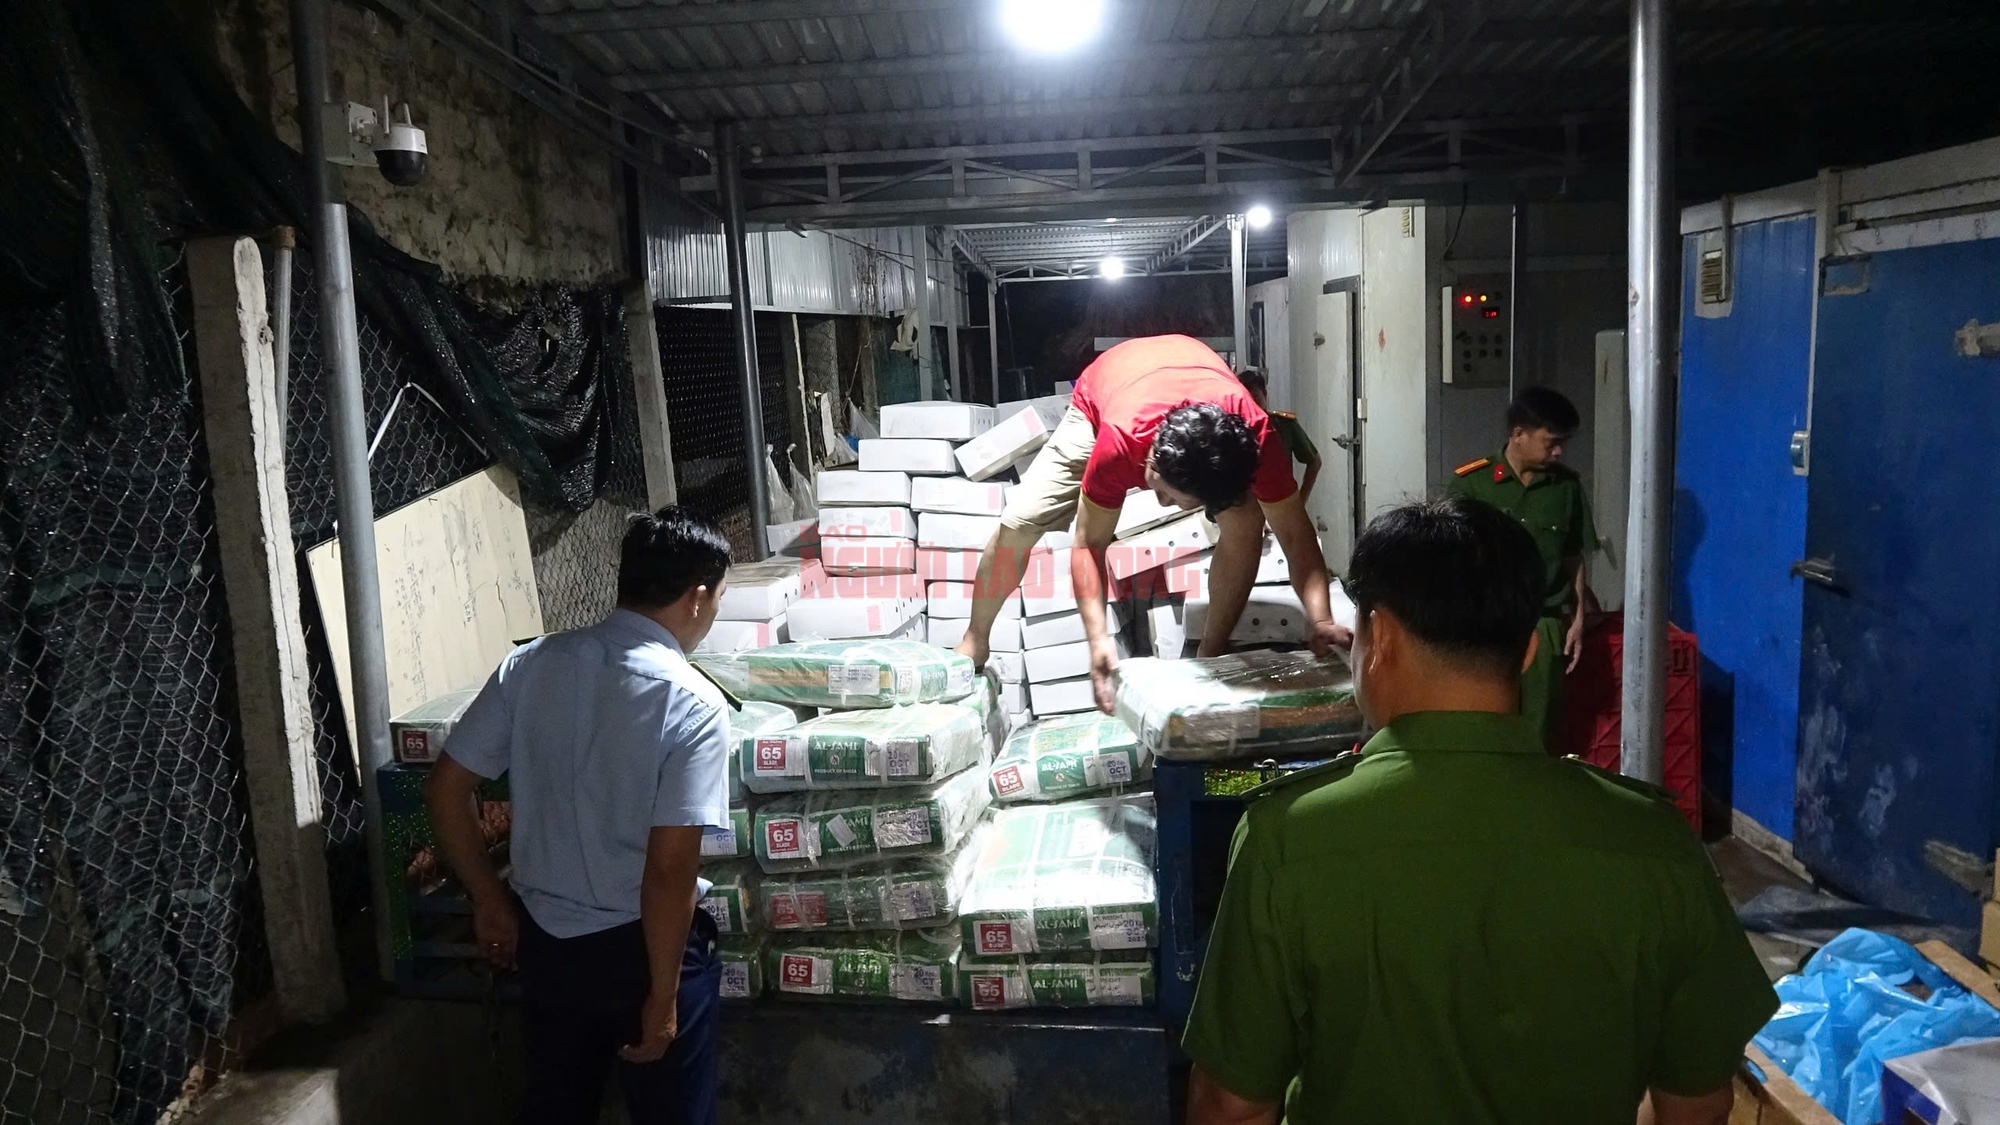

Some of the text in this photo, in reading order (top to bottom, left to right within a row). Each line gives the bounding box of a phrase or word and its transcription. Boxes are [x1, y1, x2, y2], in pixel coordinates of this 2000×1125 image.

[406, 737, 425, 750] 65
[761, 747, 782, 760] 65
[889, 759, 909, 767] OCT
[1109, 765, 1127, 775] OCT
[998, 771, 1018, 787] 65
[908, 821, 928, 829] OCT
[773, 829, 794, 843] 65
[1123, 919, 1134, 928] 20
[985, 930, 1007, 943] 65
[725, 968, 736, 976] 20
[787, 963, 808, 978] 65
[727, 977, 746, 985] OCT
